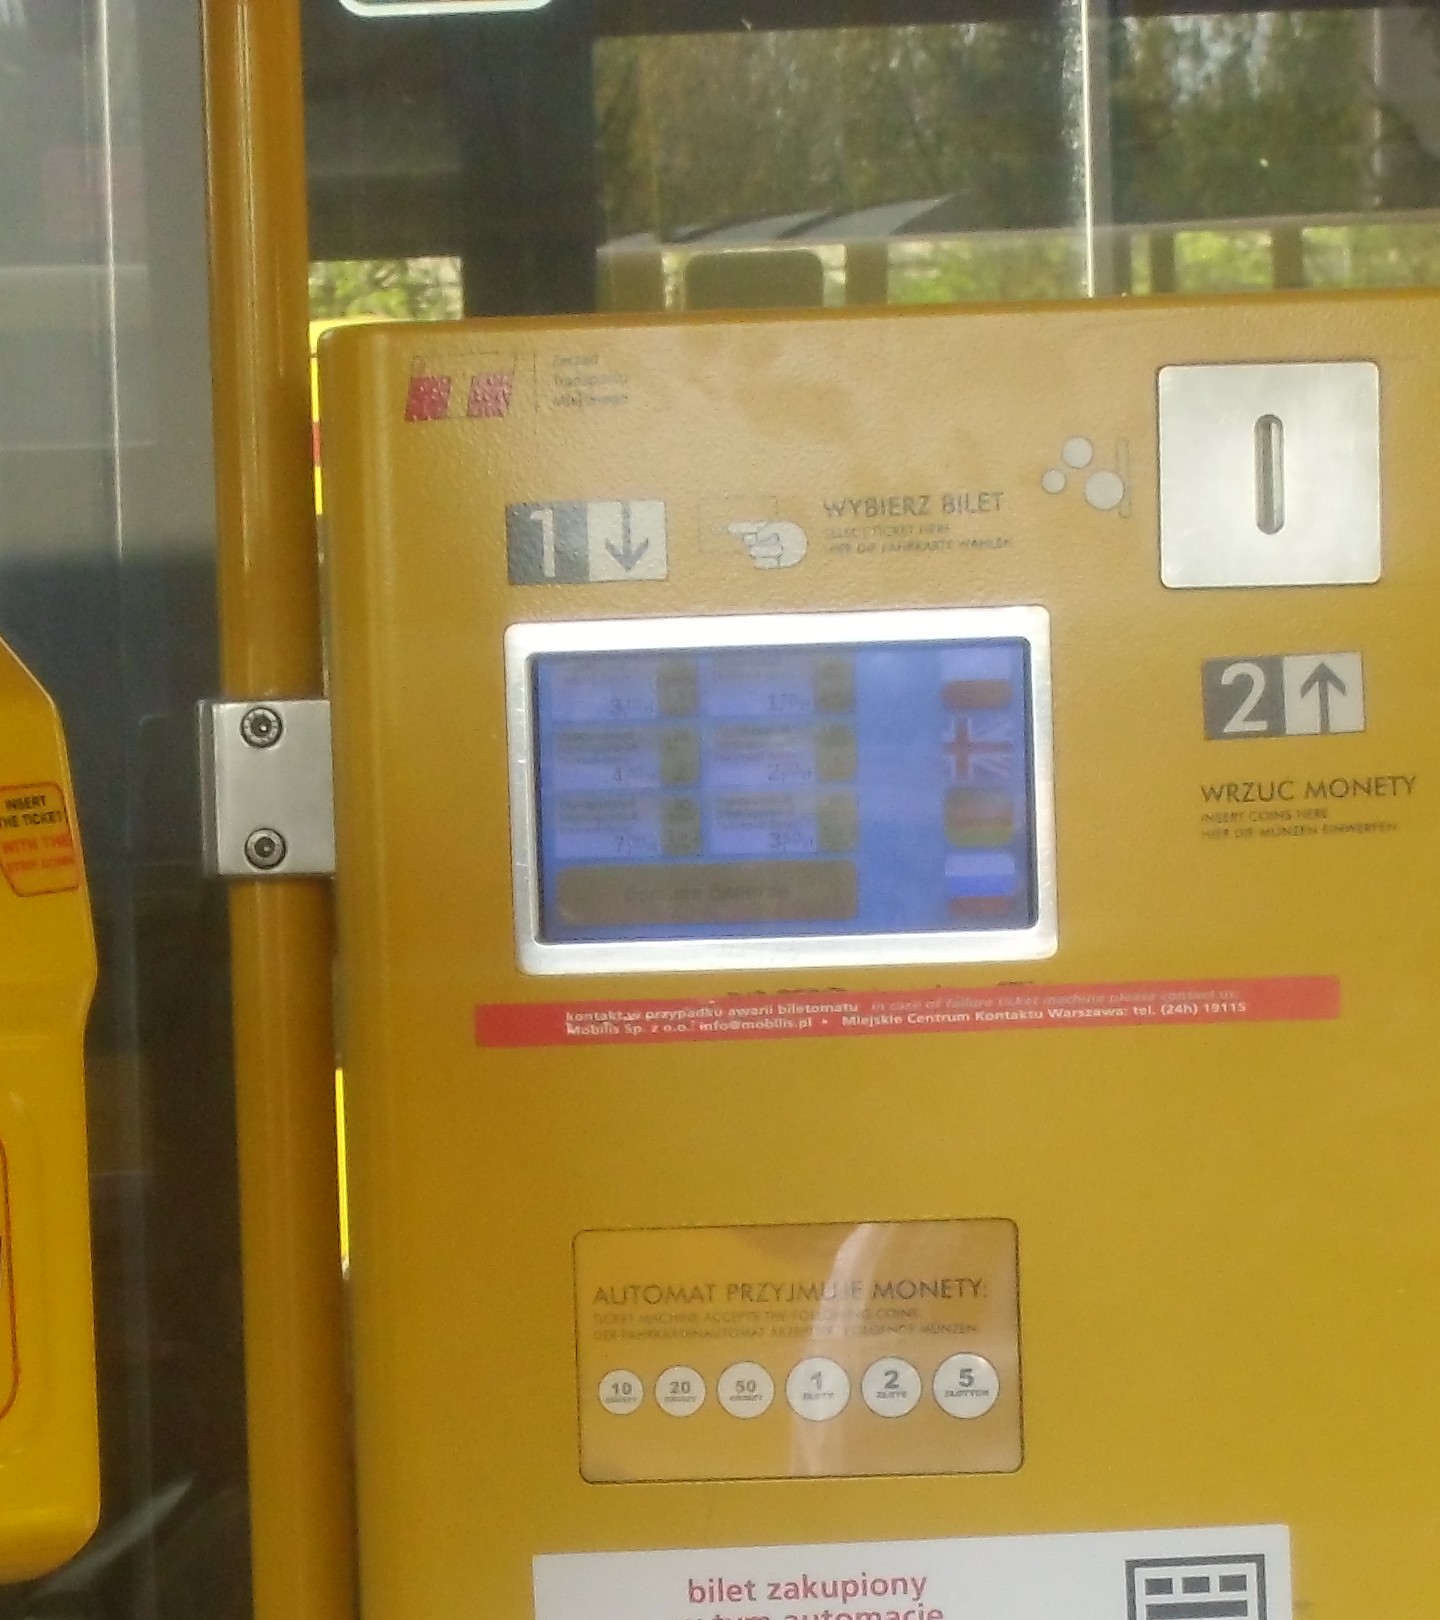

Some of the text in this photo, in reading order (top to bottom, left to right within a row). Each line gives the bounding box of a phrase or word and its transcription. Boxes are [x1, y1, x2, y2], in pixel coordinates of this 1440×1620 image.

[823, 490, 1004, 518] WYBIERZ BILET
[530, 507, 557, 579] 1
[1219, 660, 1269, 734] 2
[1303, 775, 1417, 800] MONETY
[565, 1010, 622, 1023] kontakt
[645, 1007, 724, 1021] przypadku
[728, 1005, 774, 1018] awarii
[777, 1002, 859, 1016] biletomatu
[566, 1022, 620, 1035] Mobilis
[699, 1016, 813, 1032] info@mobilis.pl
[842, 1014, 904, 1028] Miejskie
[906, 1012, 971, 1024] Centrum
[975, 1009, 1044, 1021] Kontaktu
[1133, 1005, 1157, 1015] tel.
[1160, 1002, 1199, 1016] (24h)
[1203, 1001, 1247, 1013] 19115
[592, 1283, 717, 1306] AUTOMAT
[726, 1279, 863, 1304] PRZYJMUJE
[611, 1367, 975, 1396] 10 20 50 1 2 5
[688, 1573, 928, 1606] bilet zakupiony
